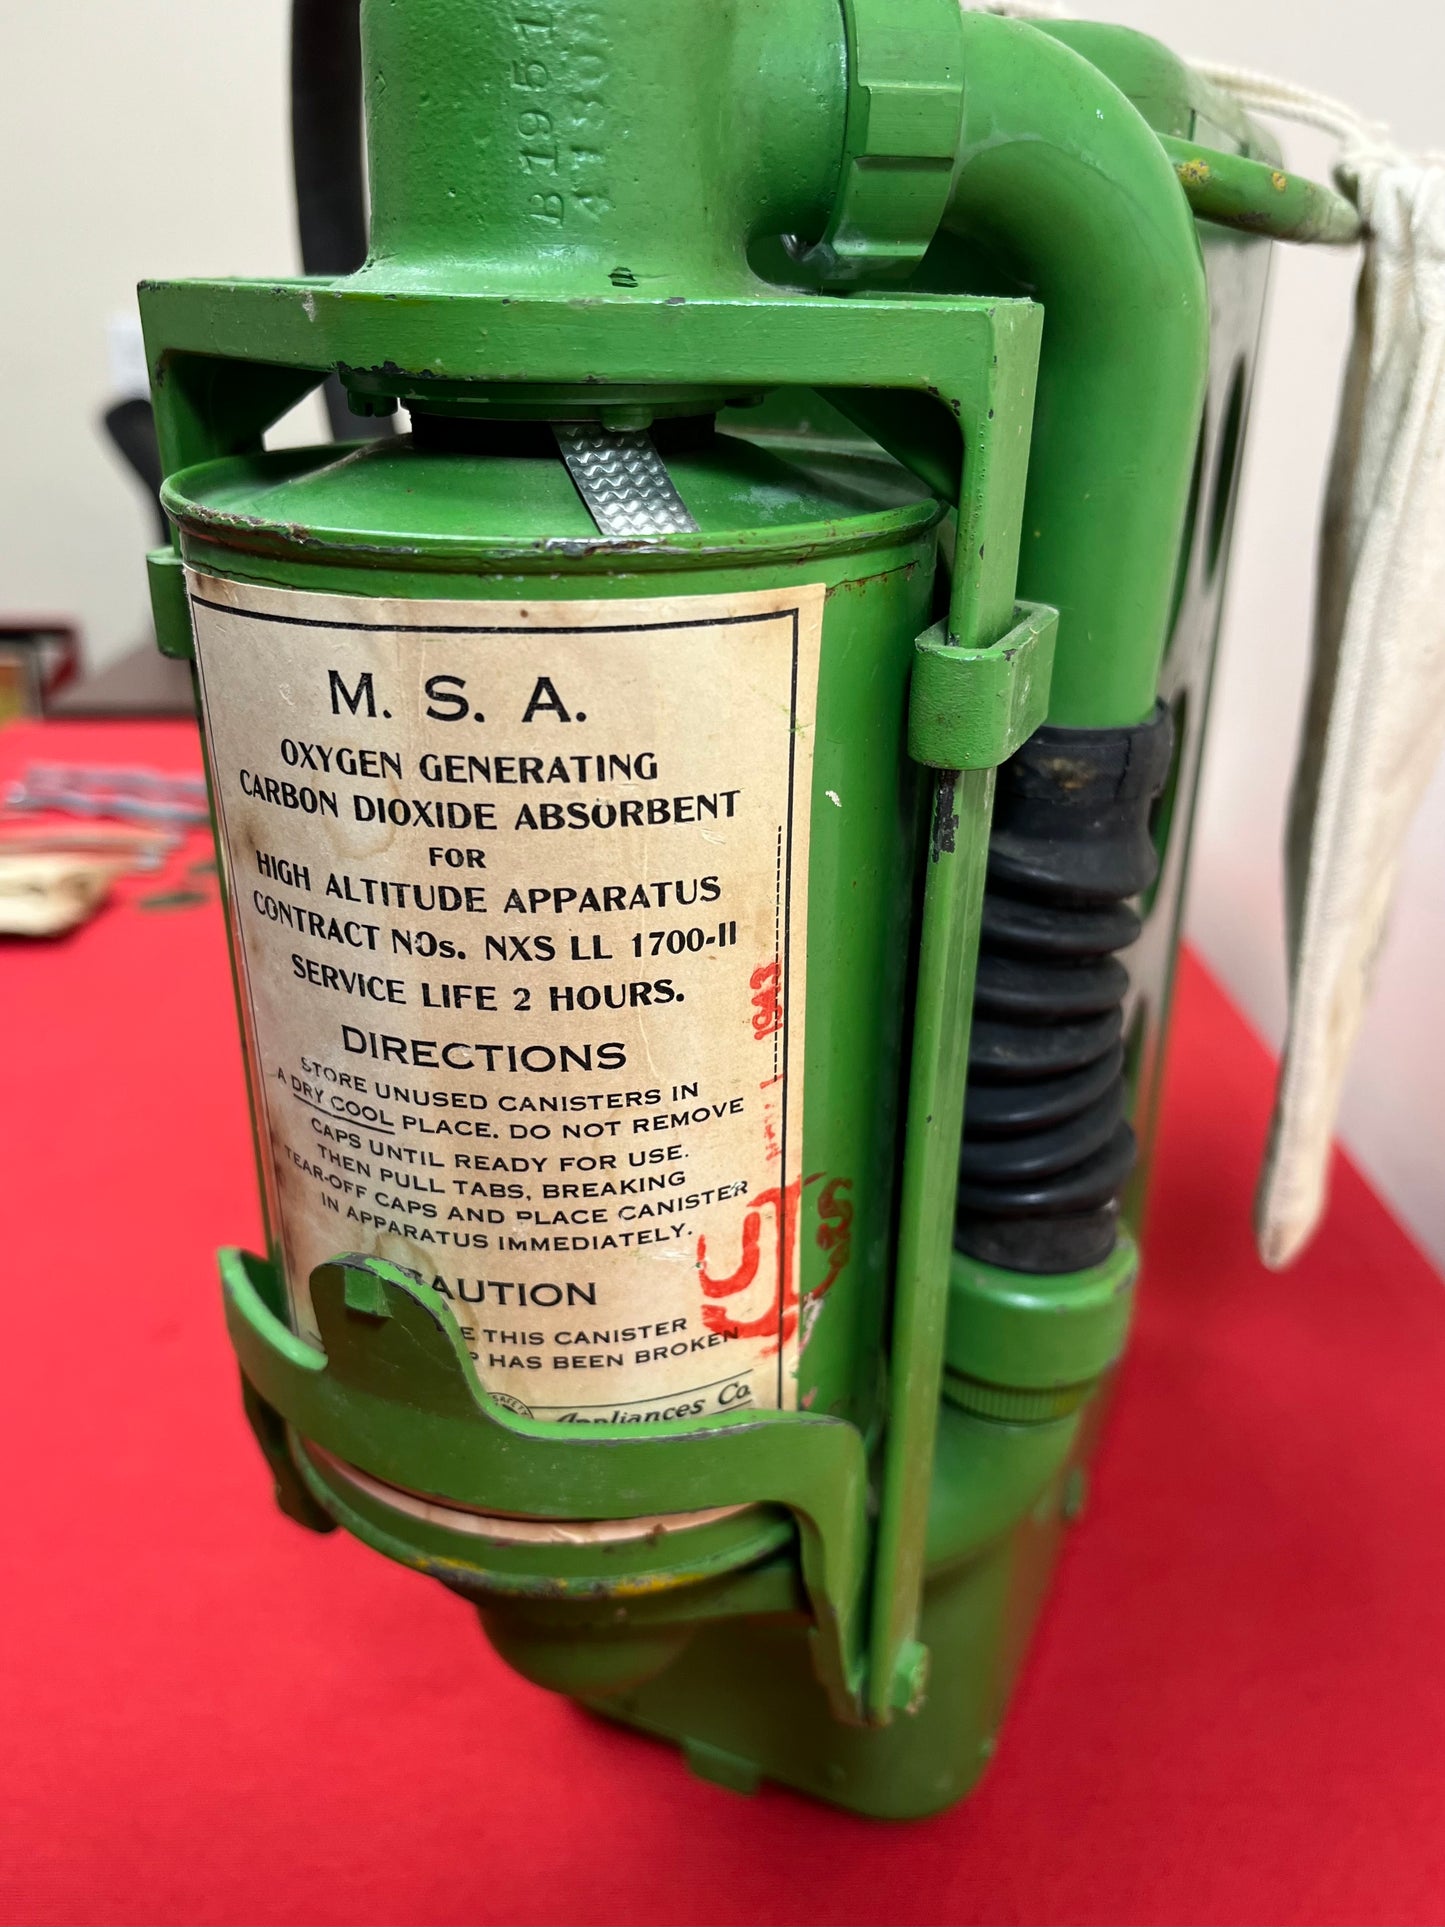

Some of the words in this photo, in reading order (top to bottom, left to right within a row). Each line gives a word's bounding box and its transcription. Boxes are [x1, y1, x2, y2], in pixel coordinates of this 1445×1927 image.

[328, 669, 392, 719] M.
[424, 674, 485, 723] S.
[521, 676, 587, 723] A.
[280, 738, 403, 780] OXYGEN
[419, 752, 658, 784] GENERATING
[239, 769, 339, 818] CARBON
[353, 794, 498, 830] DIOXIDE
[514, 788, 742, 831] ABSORBENT
[255, 849, 312, 892] HIGH
[325, 872, 488, 913] ALTITUDE
[503, 875, 722, 914] APPARATUS
[428, 846, 487, 869] FOR
[253, 890, 380, 951] CONTRACT
[485, 934, 556, 962] NXS
[570, 934, 613, 961] LL
[291, 953, 407, 1005] SERVICE
[421, 982, 498, 1012] LIFE
[512, 986, 532, 1012] 2
[549, 978, 685, 1012] HOURS.
[749, 961, 784, 1041] 1943
[341, 1023, 627, 1073] DIRECTIONS
[277, 1066, 287, 1085] A
[290, 1074, 324, 1104] DRY
[330, 1095, 395, 1127] COOL
[402, 1114, 499, 1139] PLACE.
[510, 1123, 551, 1140] DO
[563, 1120, 621, 1139] NOT
[632, 1097, 745, 1135] REMOVE
[300, 1056, 368, 1094] STORE
[375, 1082, 488, 1110] UNUSED
[498, 1088, 662, 1112] CANISTERS
[671, 1081, 699, 1102] IN
[311, 1117, 362, 1149] CAPS
[369, 1138, 445, 1168] UNTIL
[454, 1154, 548, 1173] READY
[559, 1154, 617, 1172] FOR
[628, 1144, 690, 1167] USE.
[316, 1143, 371, 1178] THEN
[380, 1168, 446, 1194] PULL
[453, 1180, 532, 1201] TABS,
[542, 1170, 687, 1200] BREAKING
[284, 1144, 368, 1199] TEAR-OFF
[374, 1192, 438, 1218] CAPS
[447, 1206, 506, 1224] AND
[516, 1208, 609, 1226] PLACE
[618, 1180, 749, 1221] CANISTER
[321, 1192, 340, 1213] IN
[346, 1206, 489, 1249] APPARATUS
[499, 1222, 694, 1252] IMMEDIATELY.
[483, 1329, 545, 1345] THIS
[553, 1317, 688, 1346] CANISTER
[489, 1353, 543, 1370] HAS
[552, 1353, 624, 1370] BEEN
[634, 1326, 739, 1364] BROKEN
